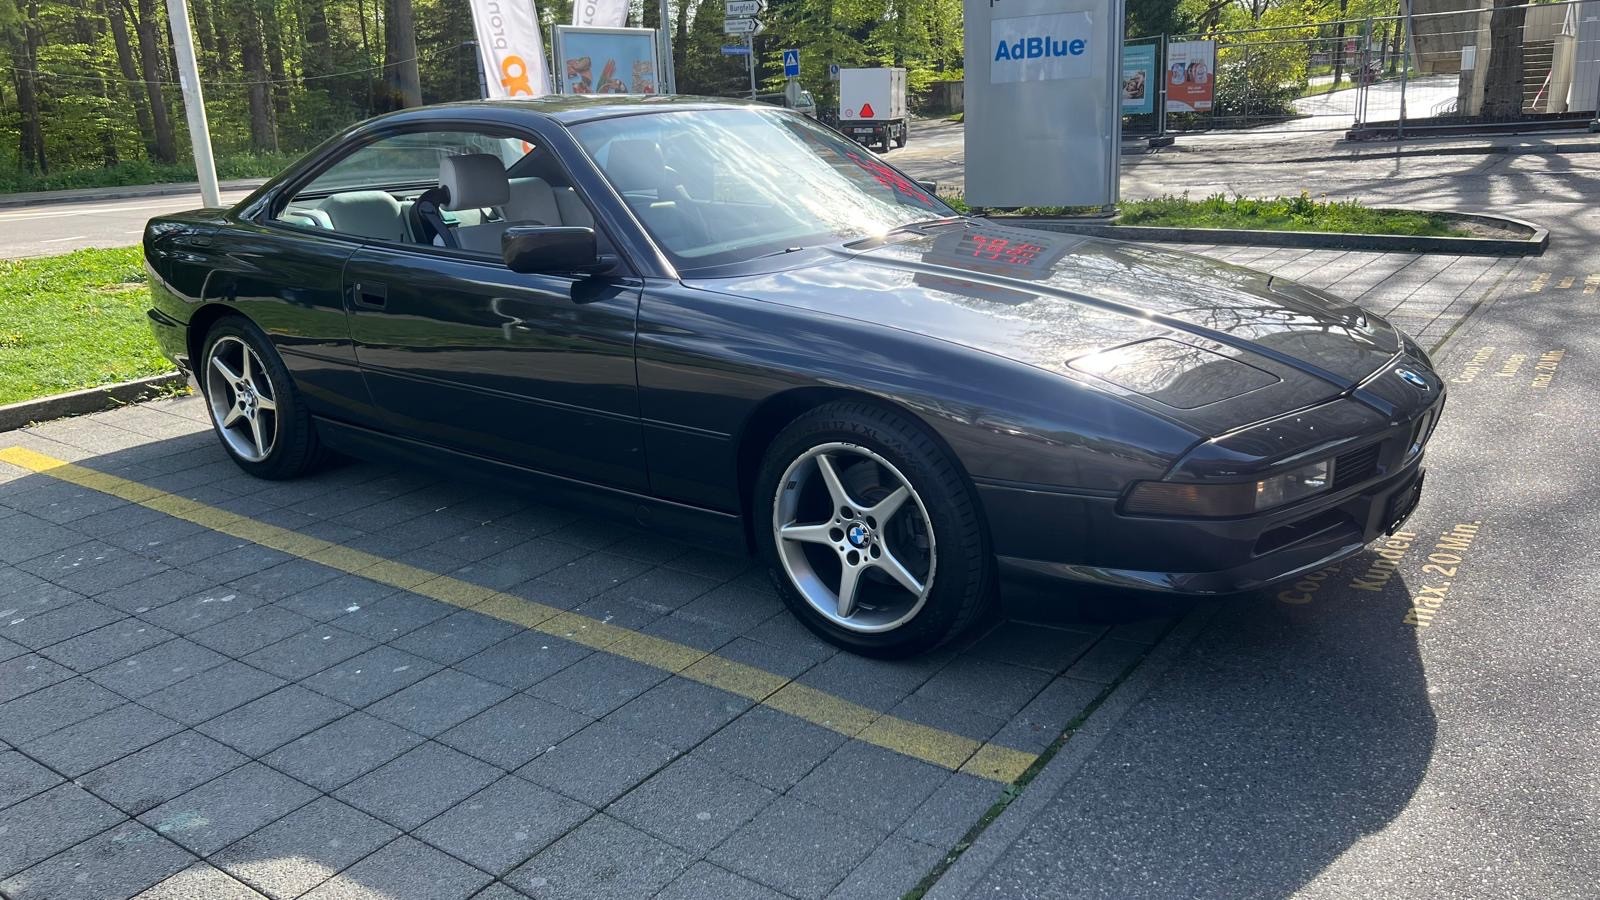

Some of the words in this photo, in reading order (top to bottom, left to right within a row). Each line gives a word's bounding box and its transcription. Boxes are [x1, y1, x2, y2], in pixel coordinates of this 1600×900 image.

[729, 4, 755, 13] Burgfeld
[994, 36, 1086, 61] AdBlue
[863, 426, 878, 438] XL
[1436, 520, 1481, 550] Min.
[1349, 531, 1417, 592] Kunden
[1422, 553, 1462, 577] 20
[1403, 581, 1451, 627] max.
